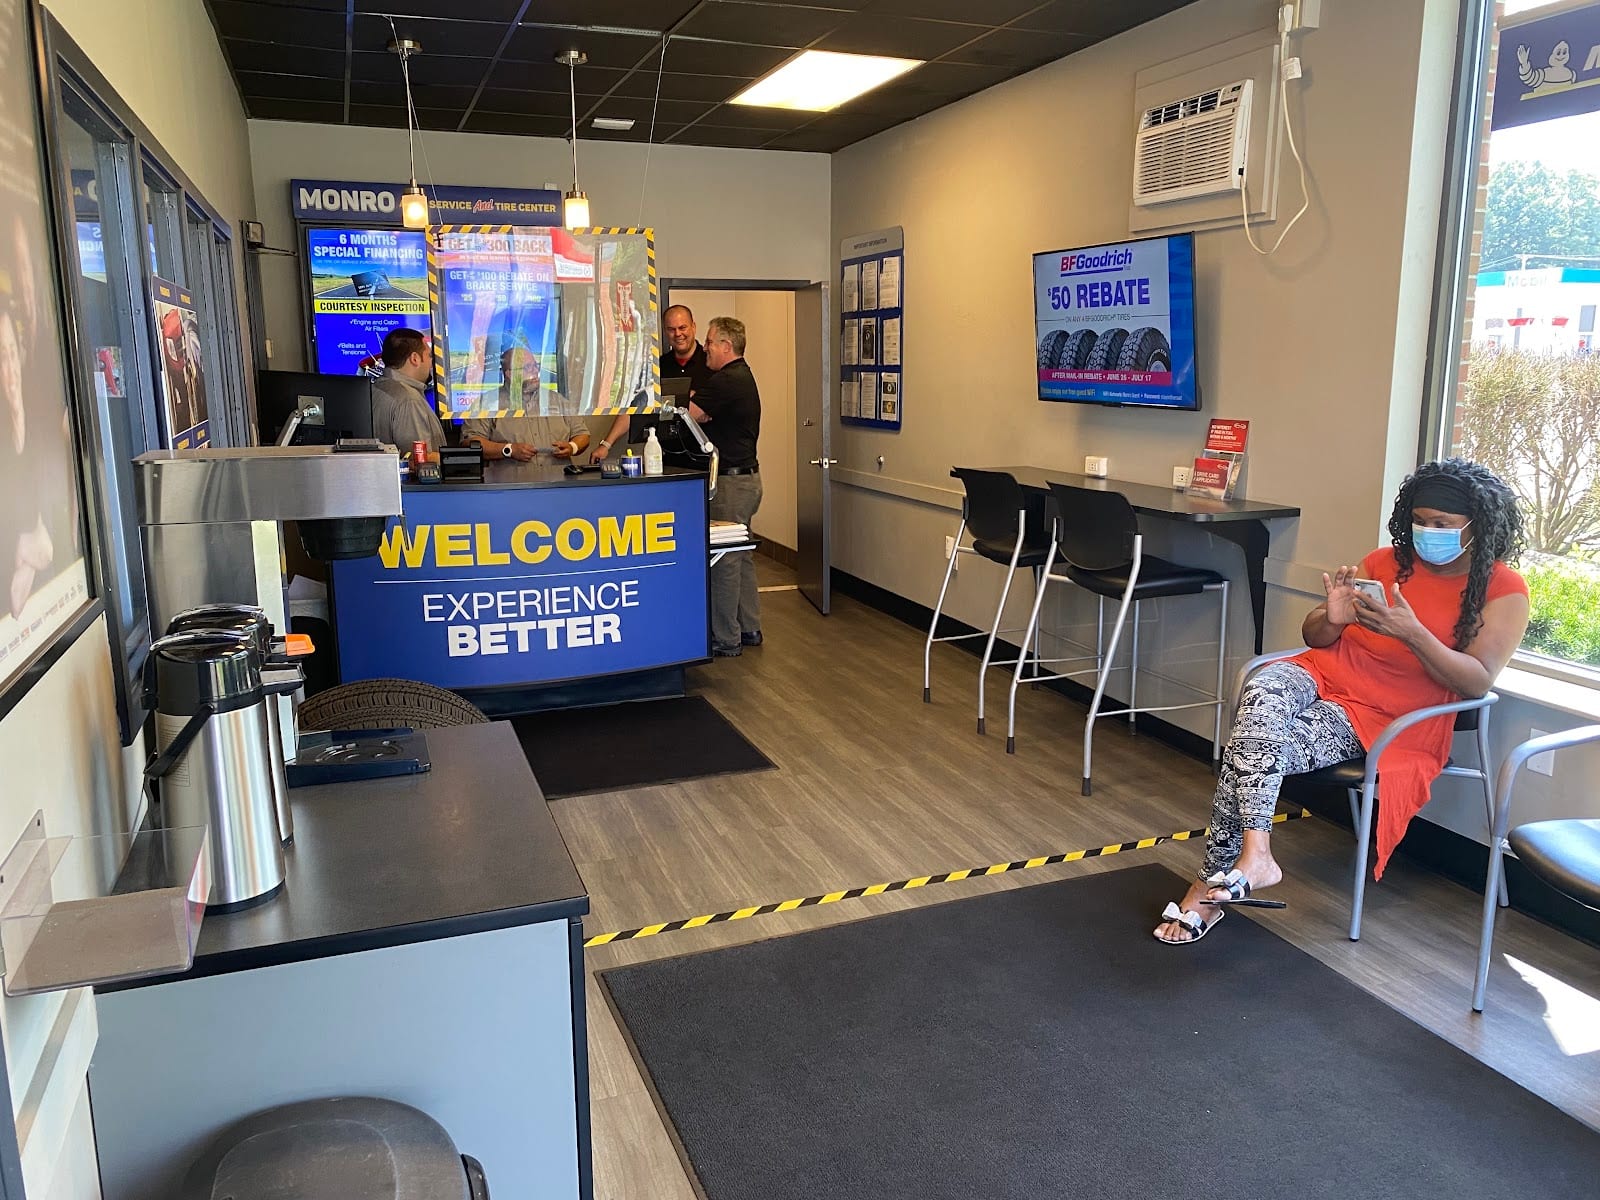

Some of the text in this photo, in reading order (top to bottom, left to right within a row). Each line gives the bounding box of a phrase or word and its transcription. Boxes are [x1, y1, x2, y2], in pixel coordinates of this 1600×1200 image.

[300, 187, 396, 214] MONRO
[429, 198, 557, 213] SERVICE And TIRE CENTER
[339, 234, 397, 246] 6 MONTHS
[448, 238, 473, 251] GET
[513, 240, 547, 254] BACK
[313, 245, 424, 260] SPECIAL FINANCING
[1060, 248, 1132, 272] BFGoodrich
[449, 270, 467, 280] GET
[500, 272, 534, 282] REBATE
[466, 281, 538, 292] BRAKE SERVICE
[1048, 278, 1151, 310] $50 REBATE
[320, 302, 425, 312] COURTESY INSPECTION
[1131, 374, 1144, 382] JULY
[378, 511, 677, 568] WELCOME
[422, 580, 640, 623] EXPERIENCE
[447, 613, 622, 657] BETTER
